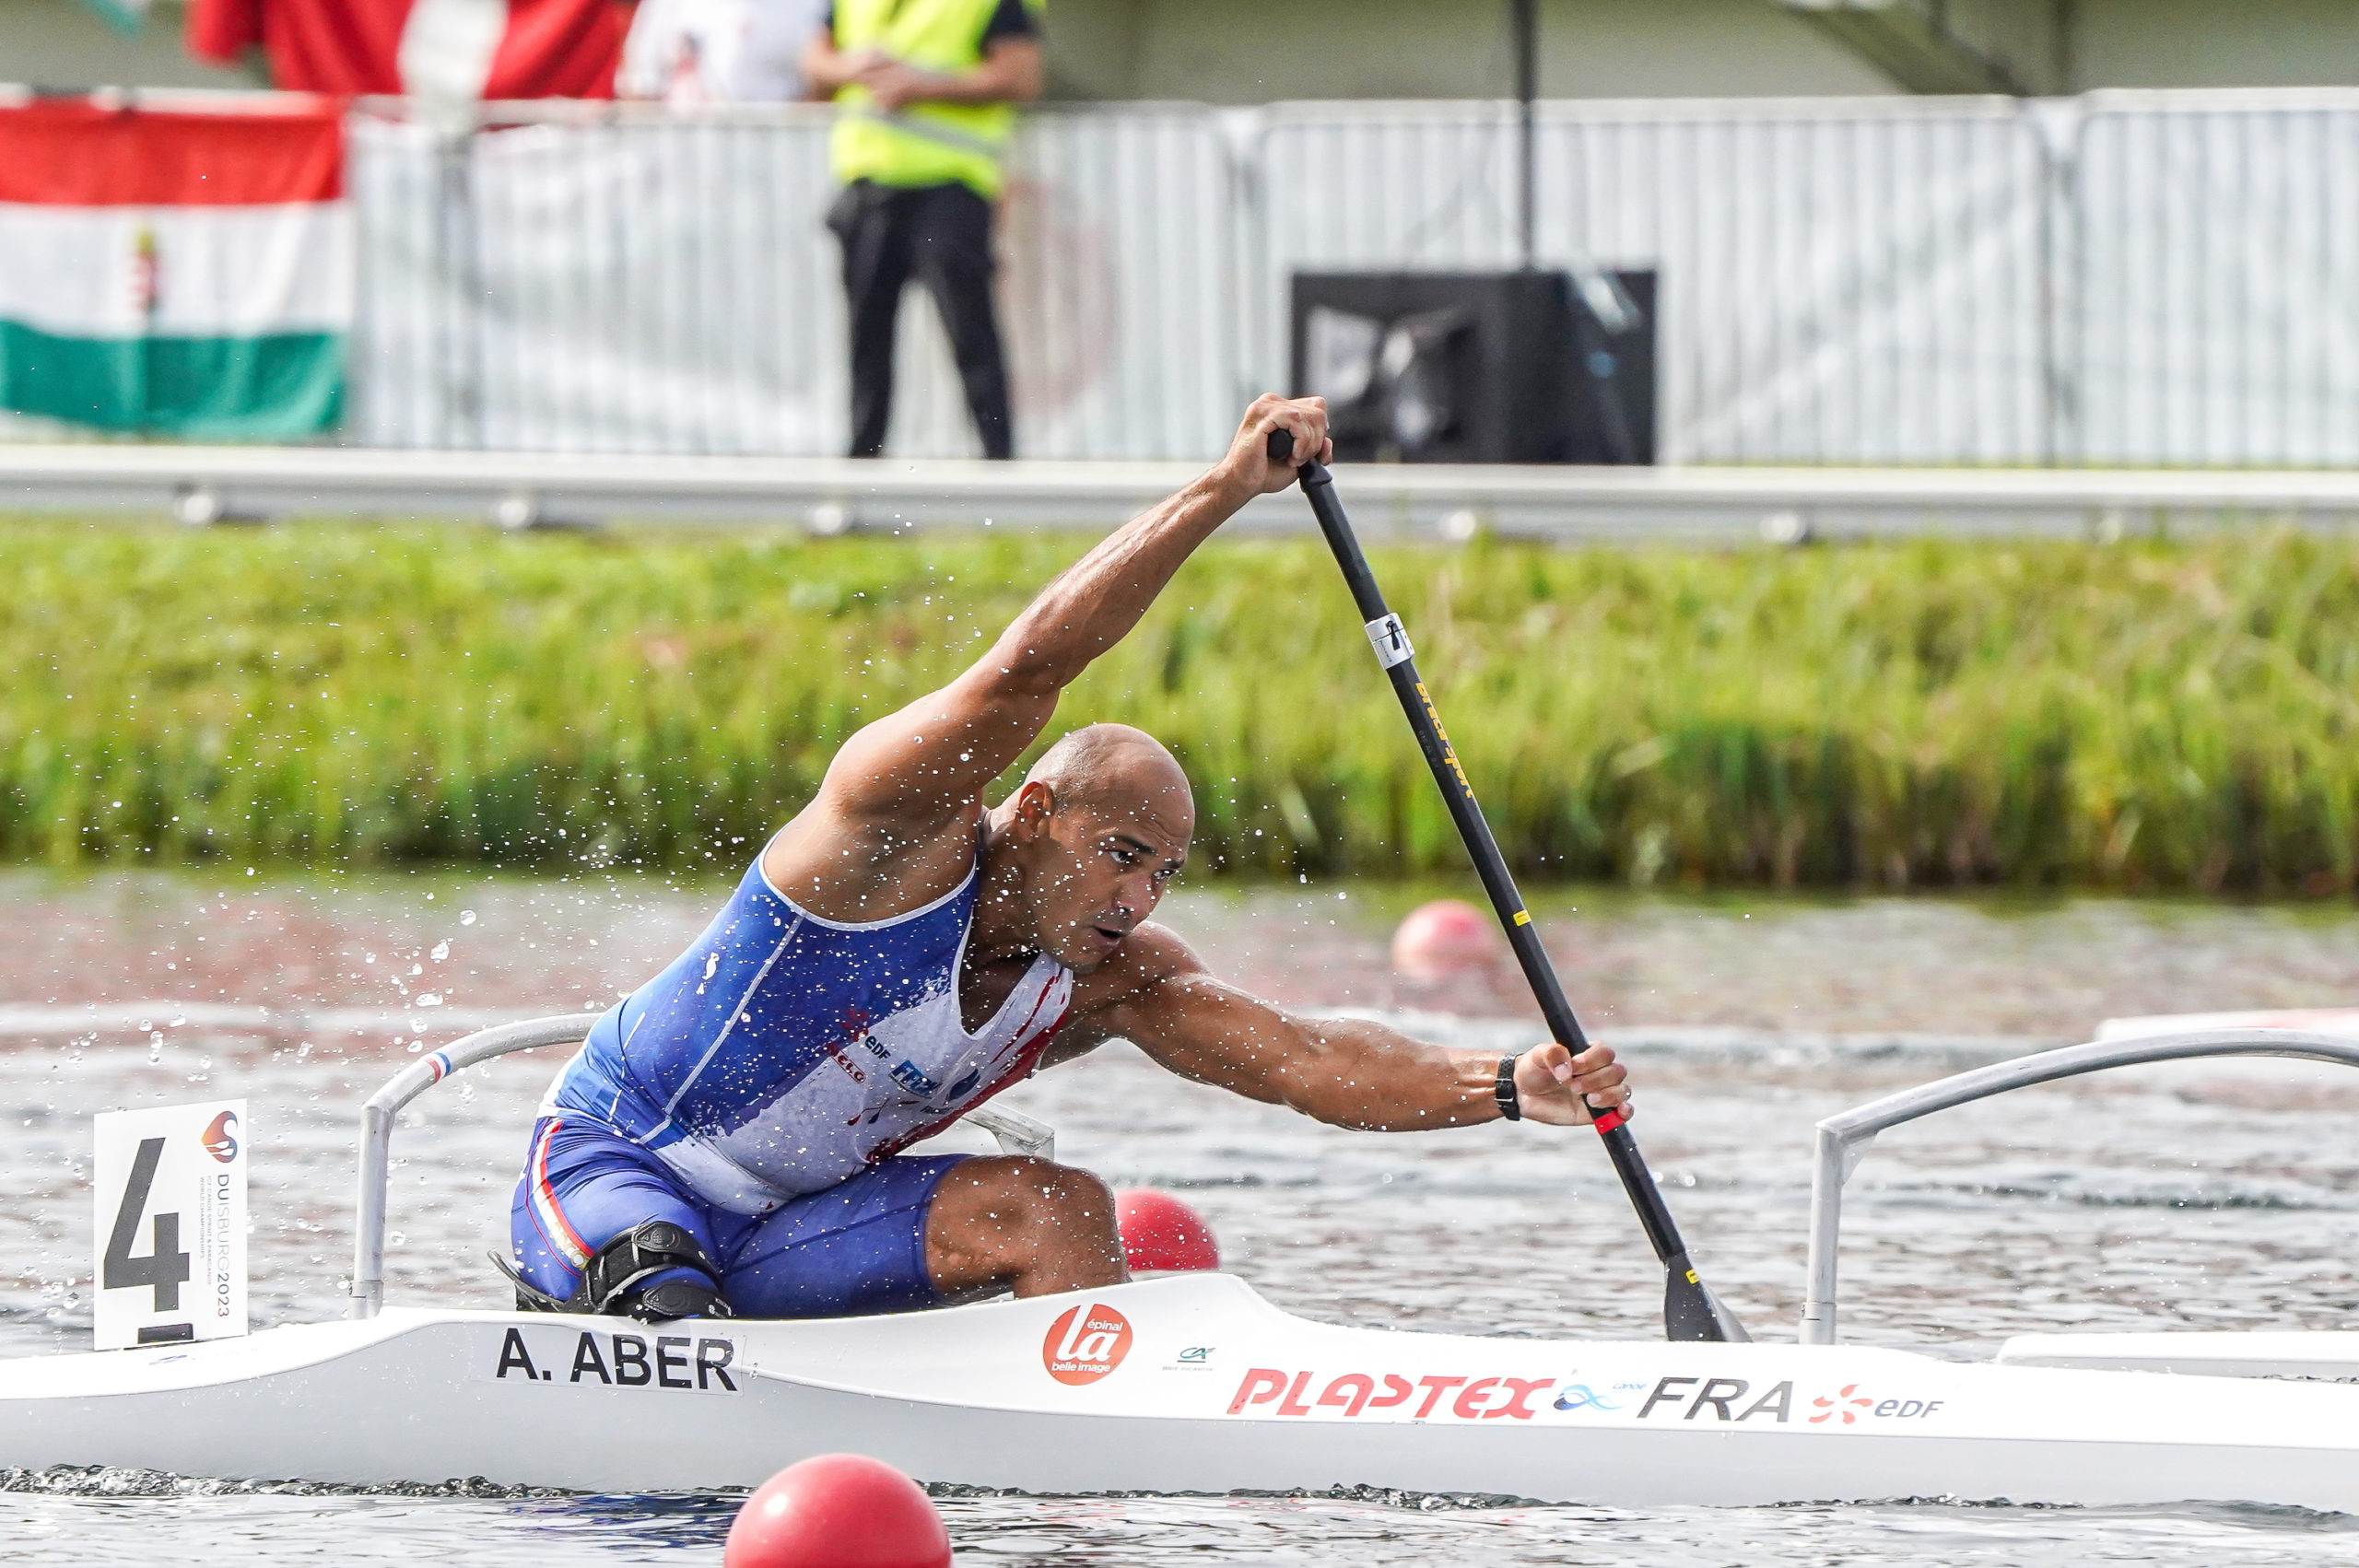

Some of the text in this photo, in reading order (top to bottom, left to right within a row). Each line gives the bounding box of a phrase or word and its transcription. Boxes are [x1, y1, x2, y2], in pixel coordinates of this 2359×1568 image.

[103, 1137, 190, 1313] 4
[217, 1174, 229, 1317] DUISBURG2023
[1056, 1305, 1120, 1362] la
[1087, 1319, 1123, 1332] épinal
[497, 1328, 738, 1391] A. ABER
[1051, 1362, 1111, 1374] belle image
[1226, 1368, 1557, 1420] PLASTEX
[1637, 1376, 1793, 1423] FRA
